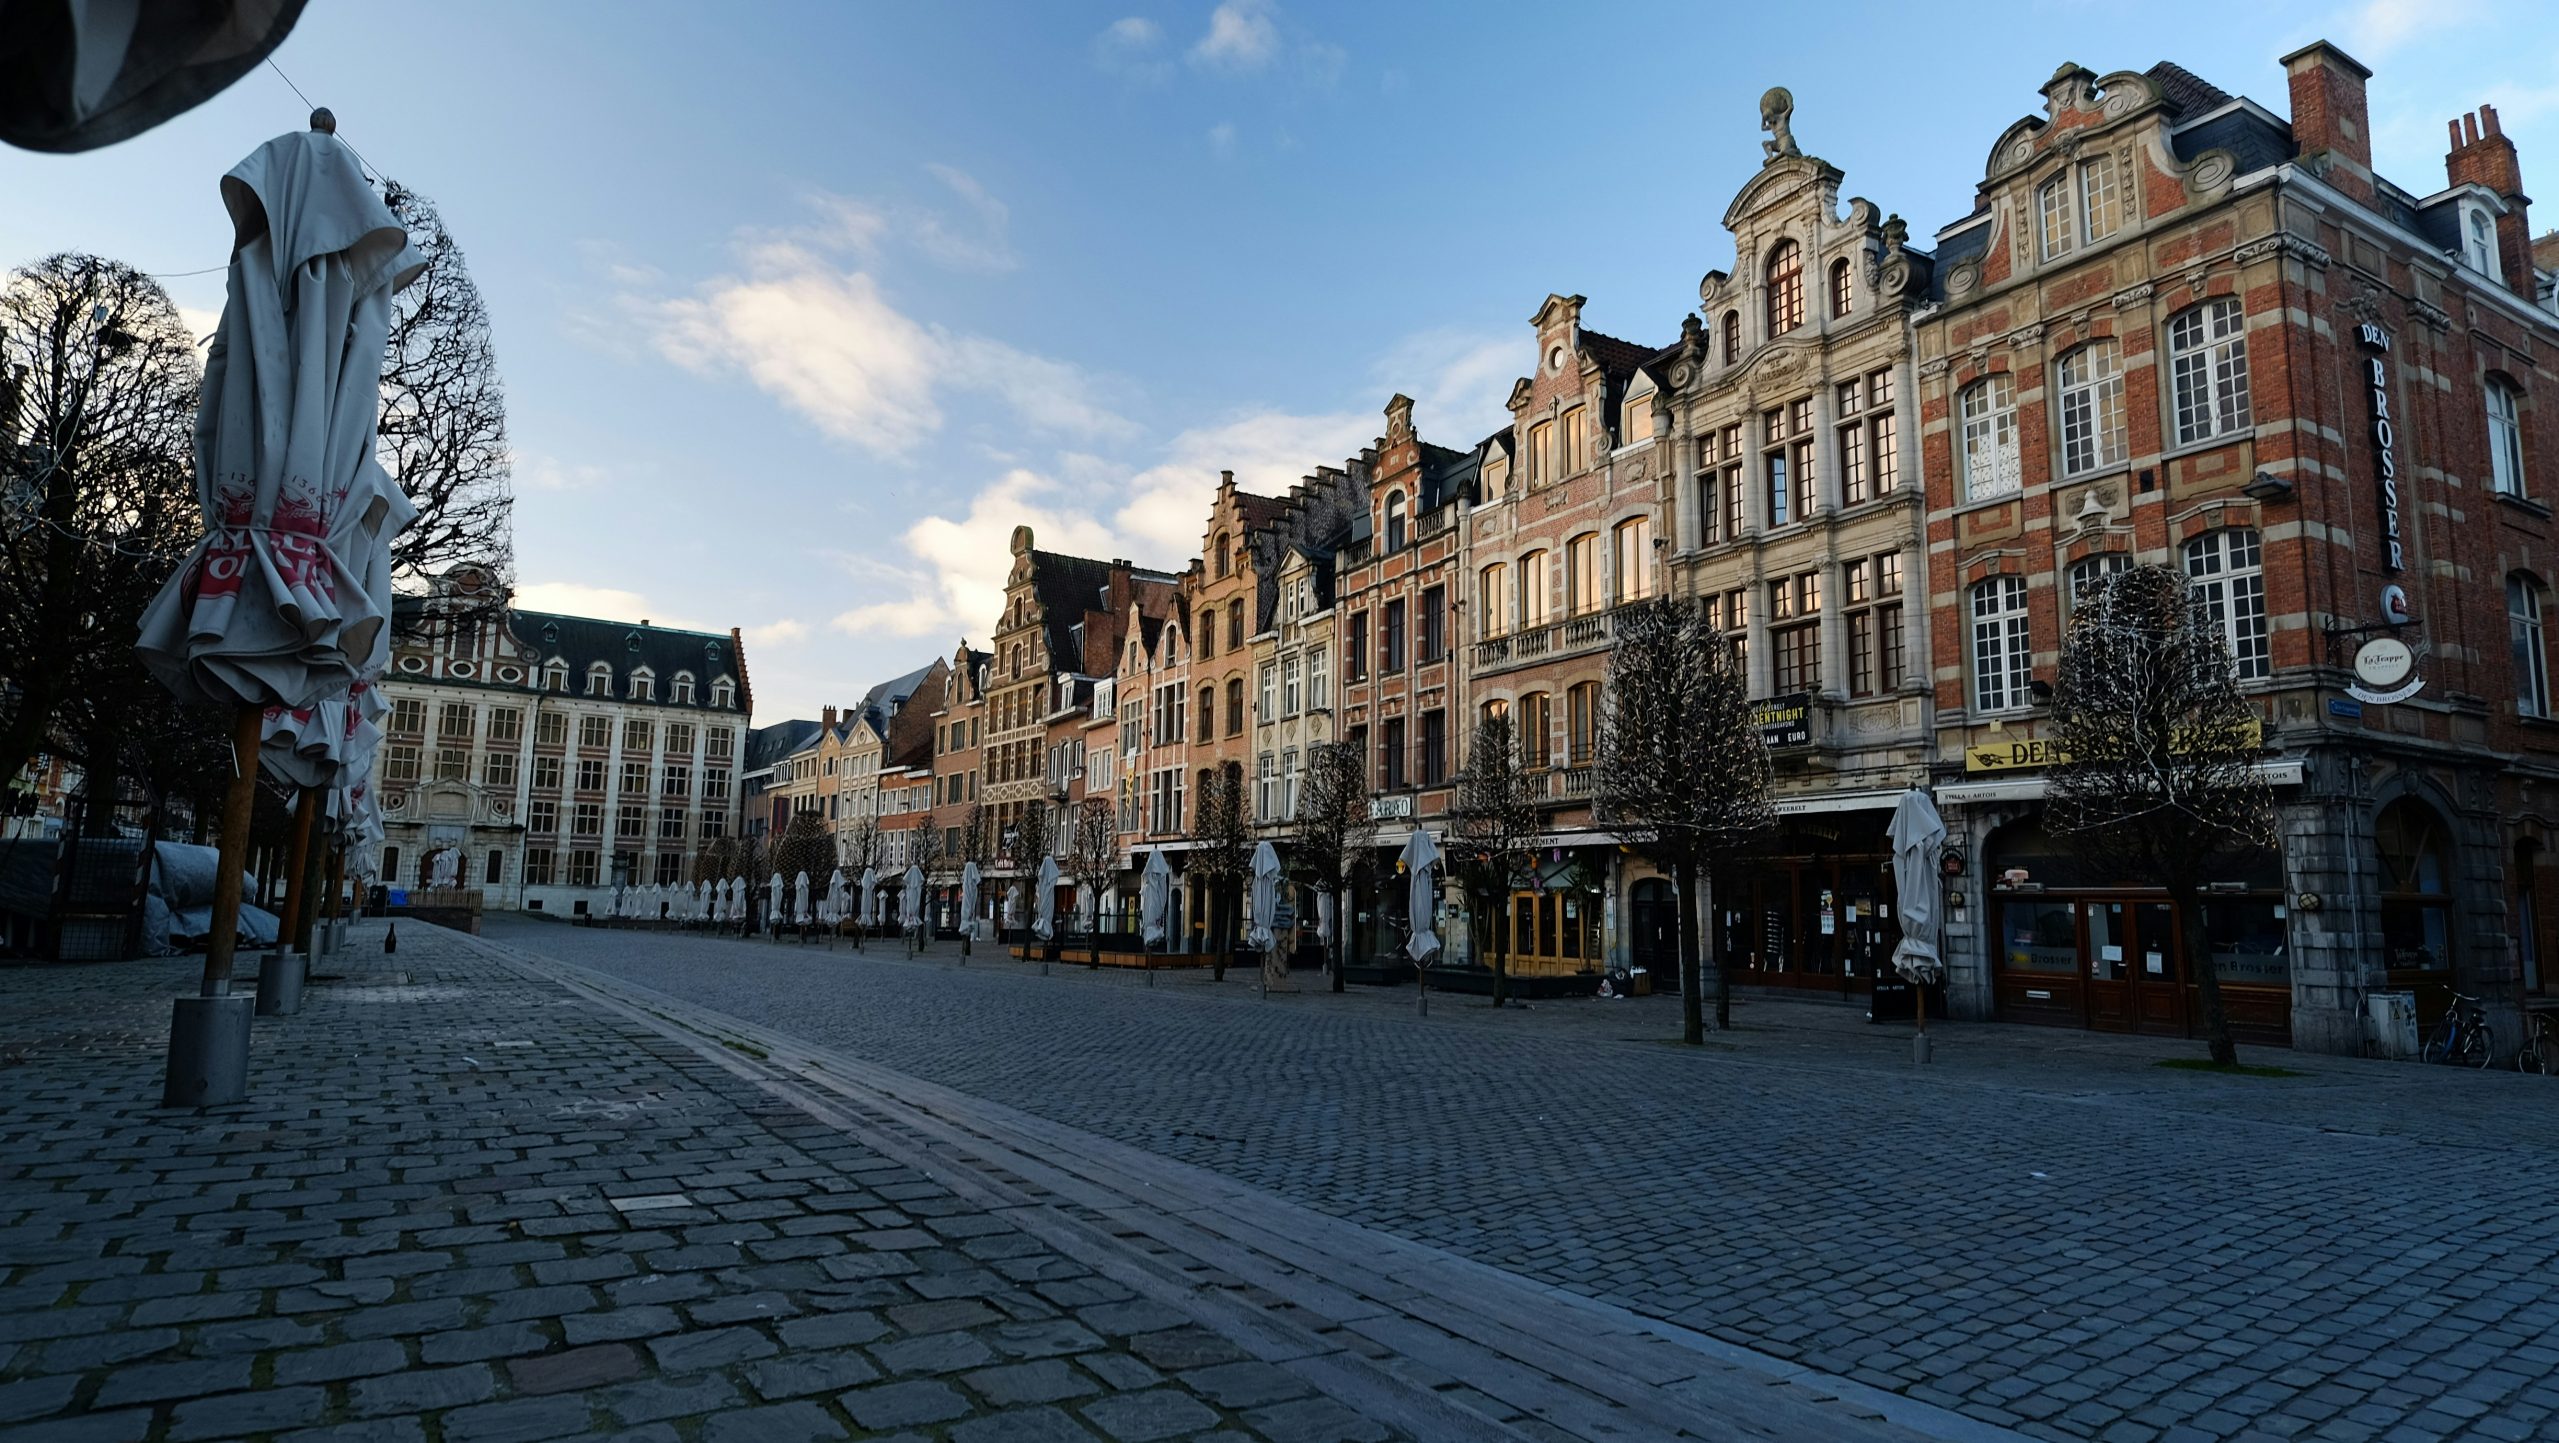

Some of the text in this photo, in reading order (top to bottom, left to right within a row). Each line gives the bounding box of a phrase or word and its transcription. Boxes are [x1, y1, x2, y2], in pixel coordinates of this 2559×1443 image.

[2361, 323, 2390, 352] DEN
[2371, 357, 2404, 572] BROSSER
[2357, 688, 2413, 702] DEN BROSSER
[1766, 730, 1806, 745] AAN EURO
